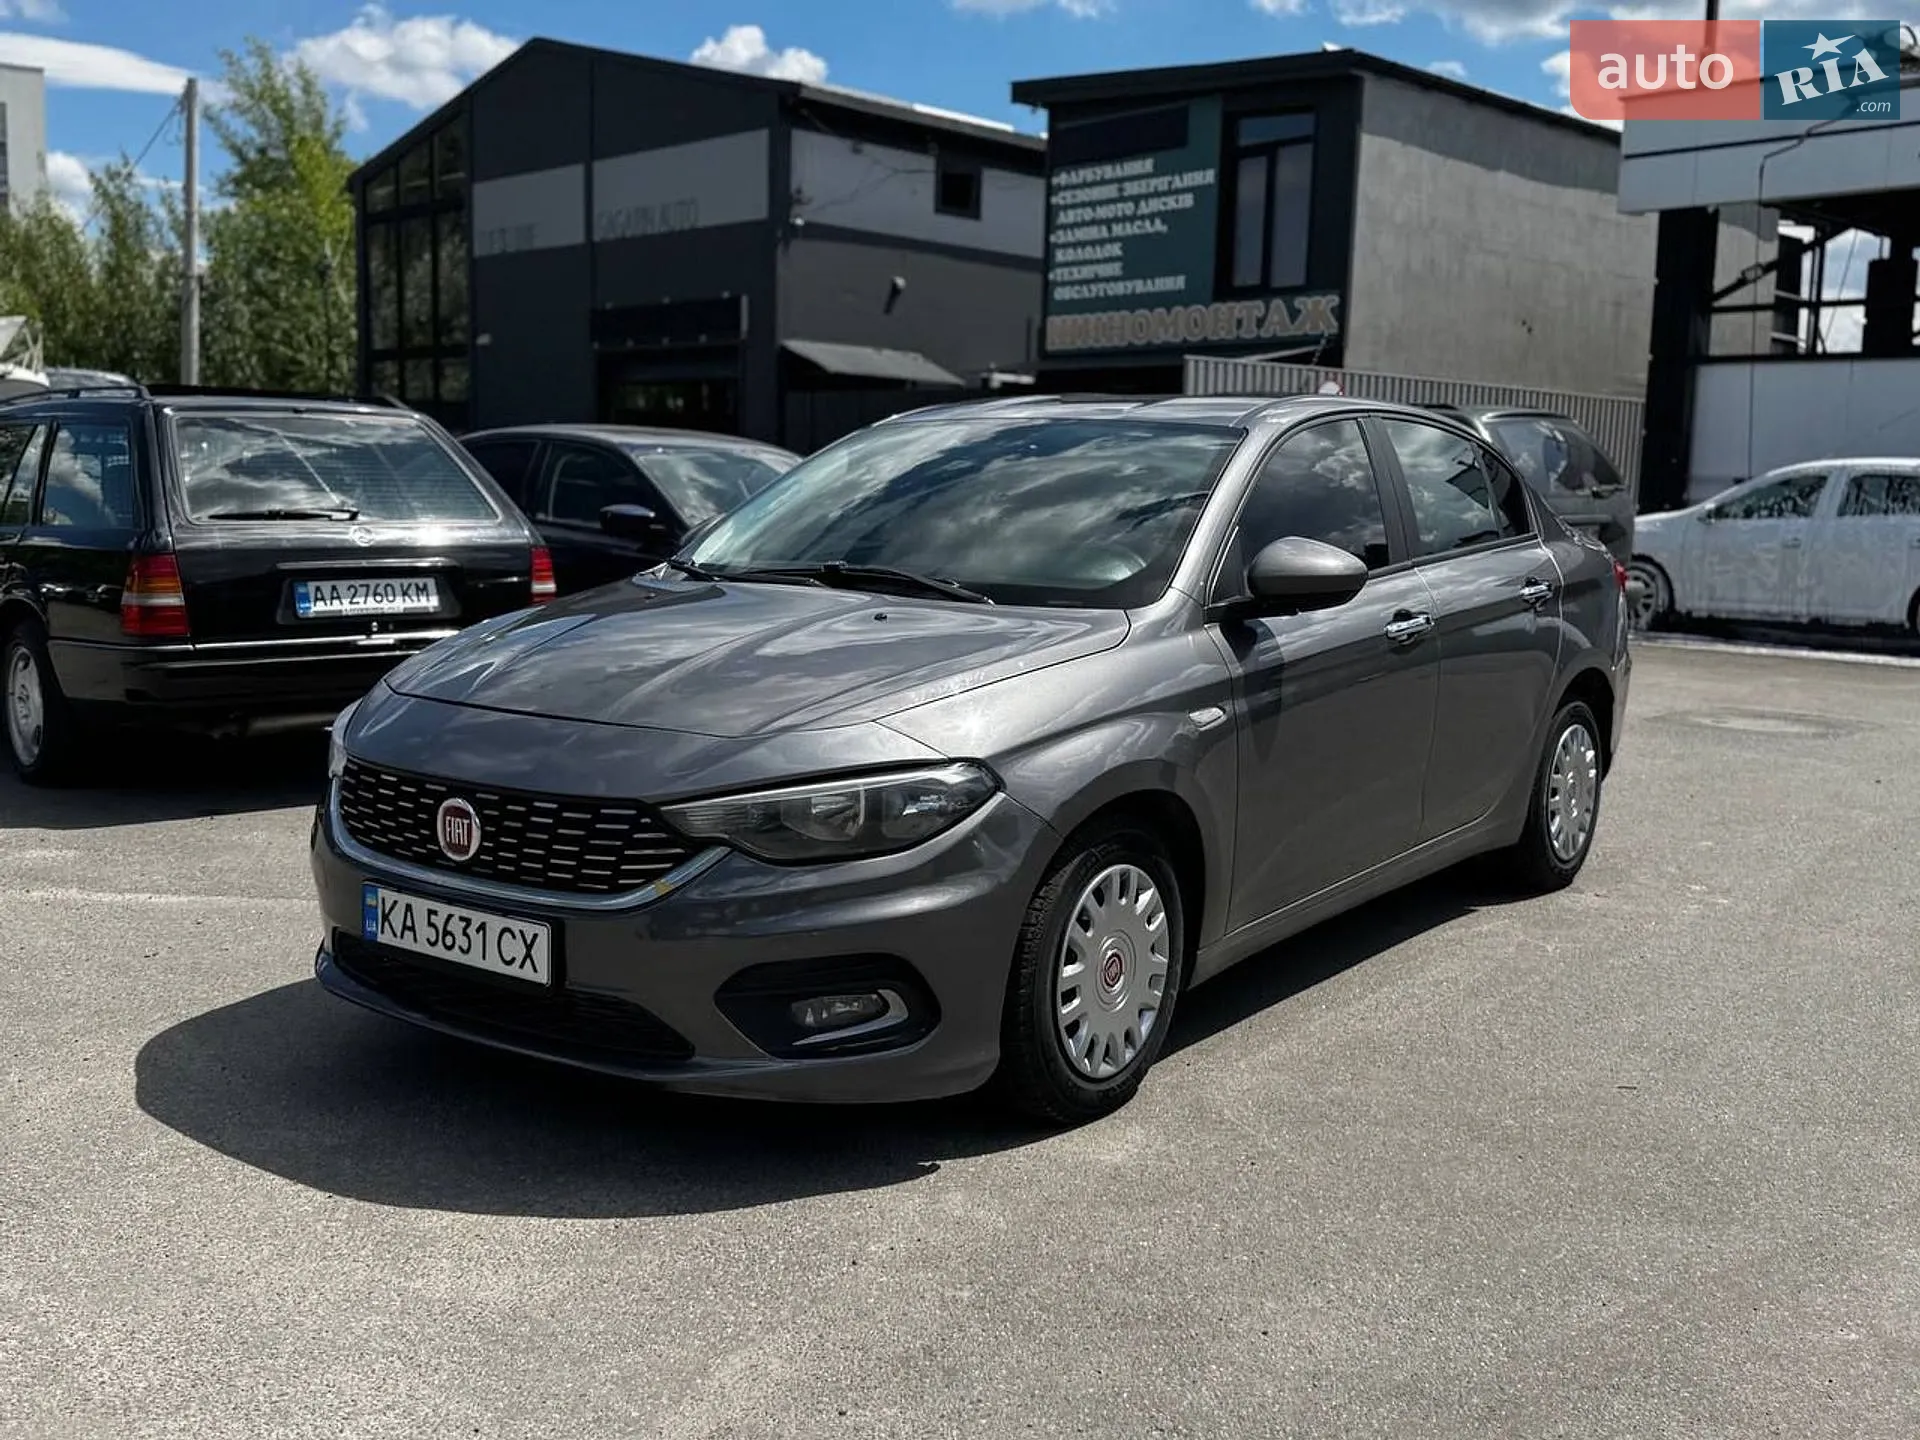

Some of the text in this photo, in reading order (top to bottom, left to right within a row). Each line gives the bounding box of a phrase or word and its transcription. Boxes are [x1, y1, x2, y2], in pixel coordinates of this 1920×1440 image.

[1046, 294, 1340, 350] ШИНОМОНТАЖ
[313, 582, 432, 607] AA 2760 KM
[445, 815, 470, 847] FIAT
[380, 897, 539, 973] KA 5631 CX
